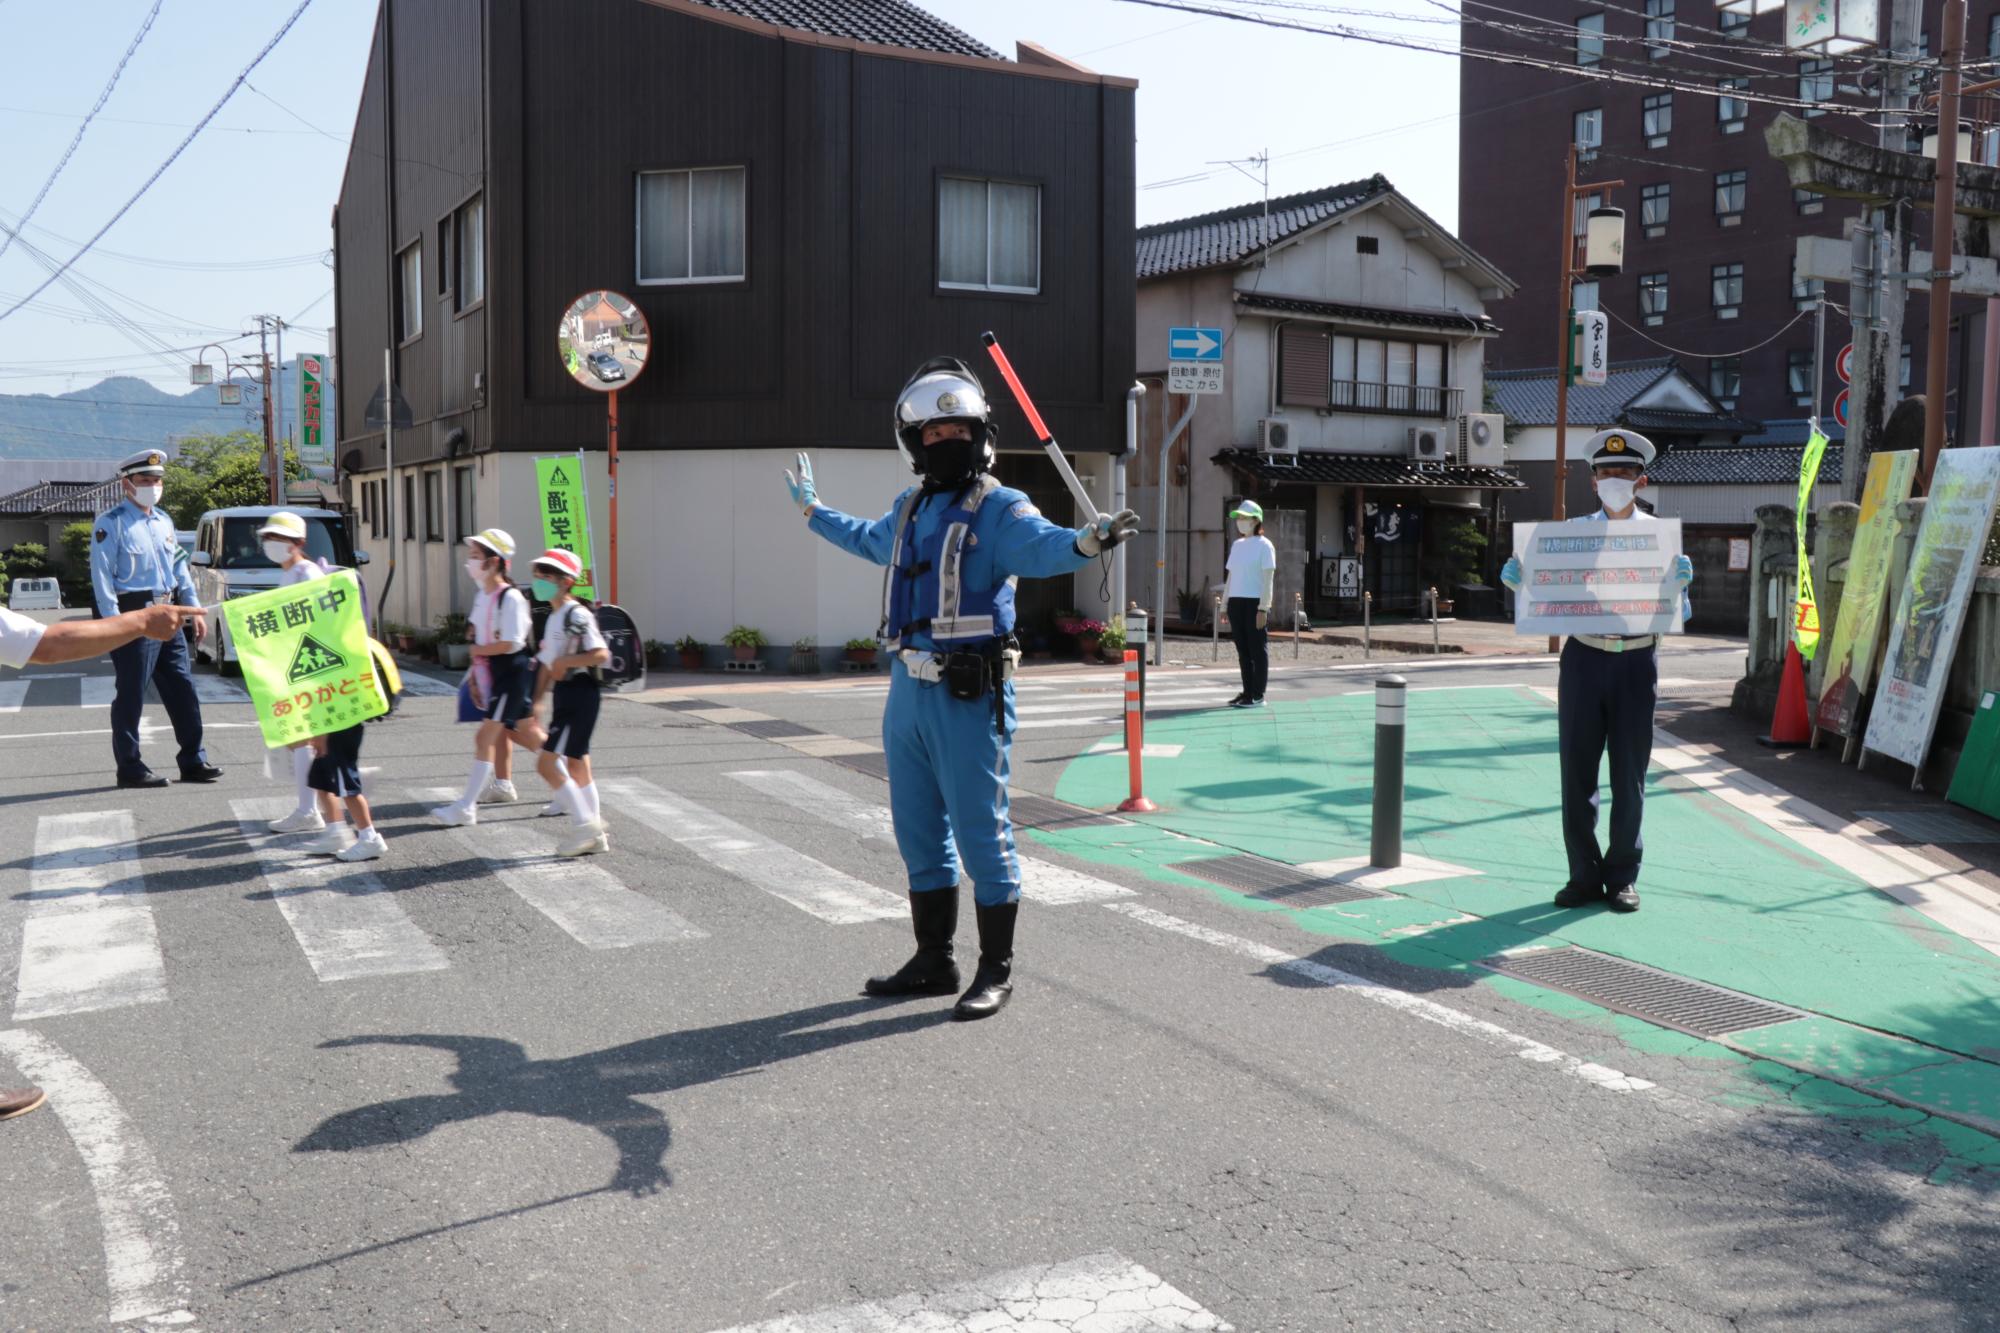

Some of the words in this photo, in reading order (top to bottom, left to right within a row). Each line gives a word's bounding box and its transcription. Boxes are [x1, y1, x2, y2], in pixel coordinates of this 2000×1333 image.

[1174, 380, 1218, 390] ここから
[304, 381, 321, 444] フジカラー
[1544, 537, 1648, 552] 横断歩道は
[245, 588, 347, 639] 横断中
